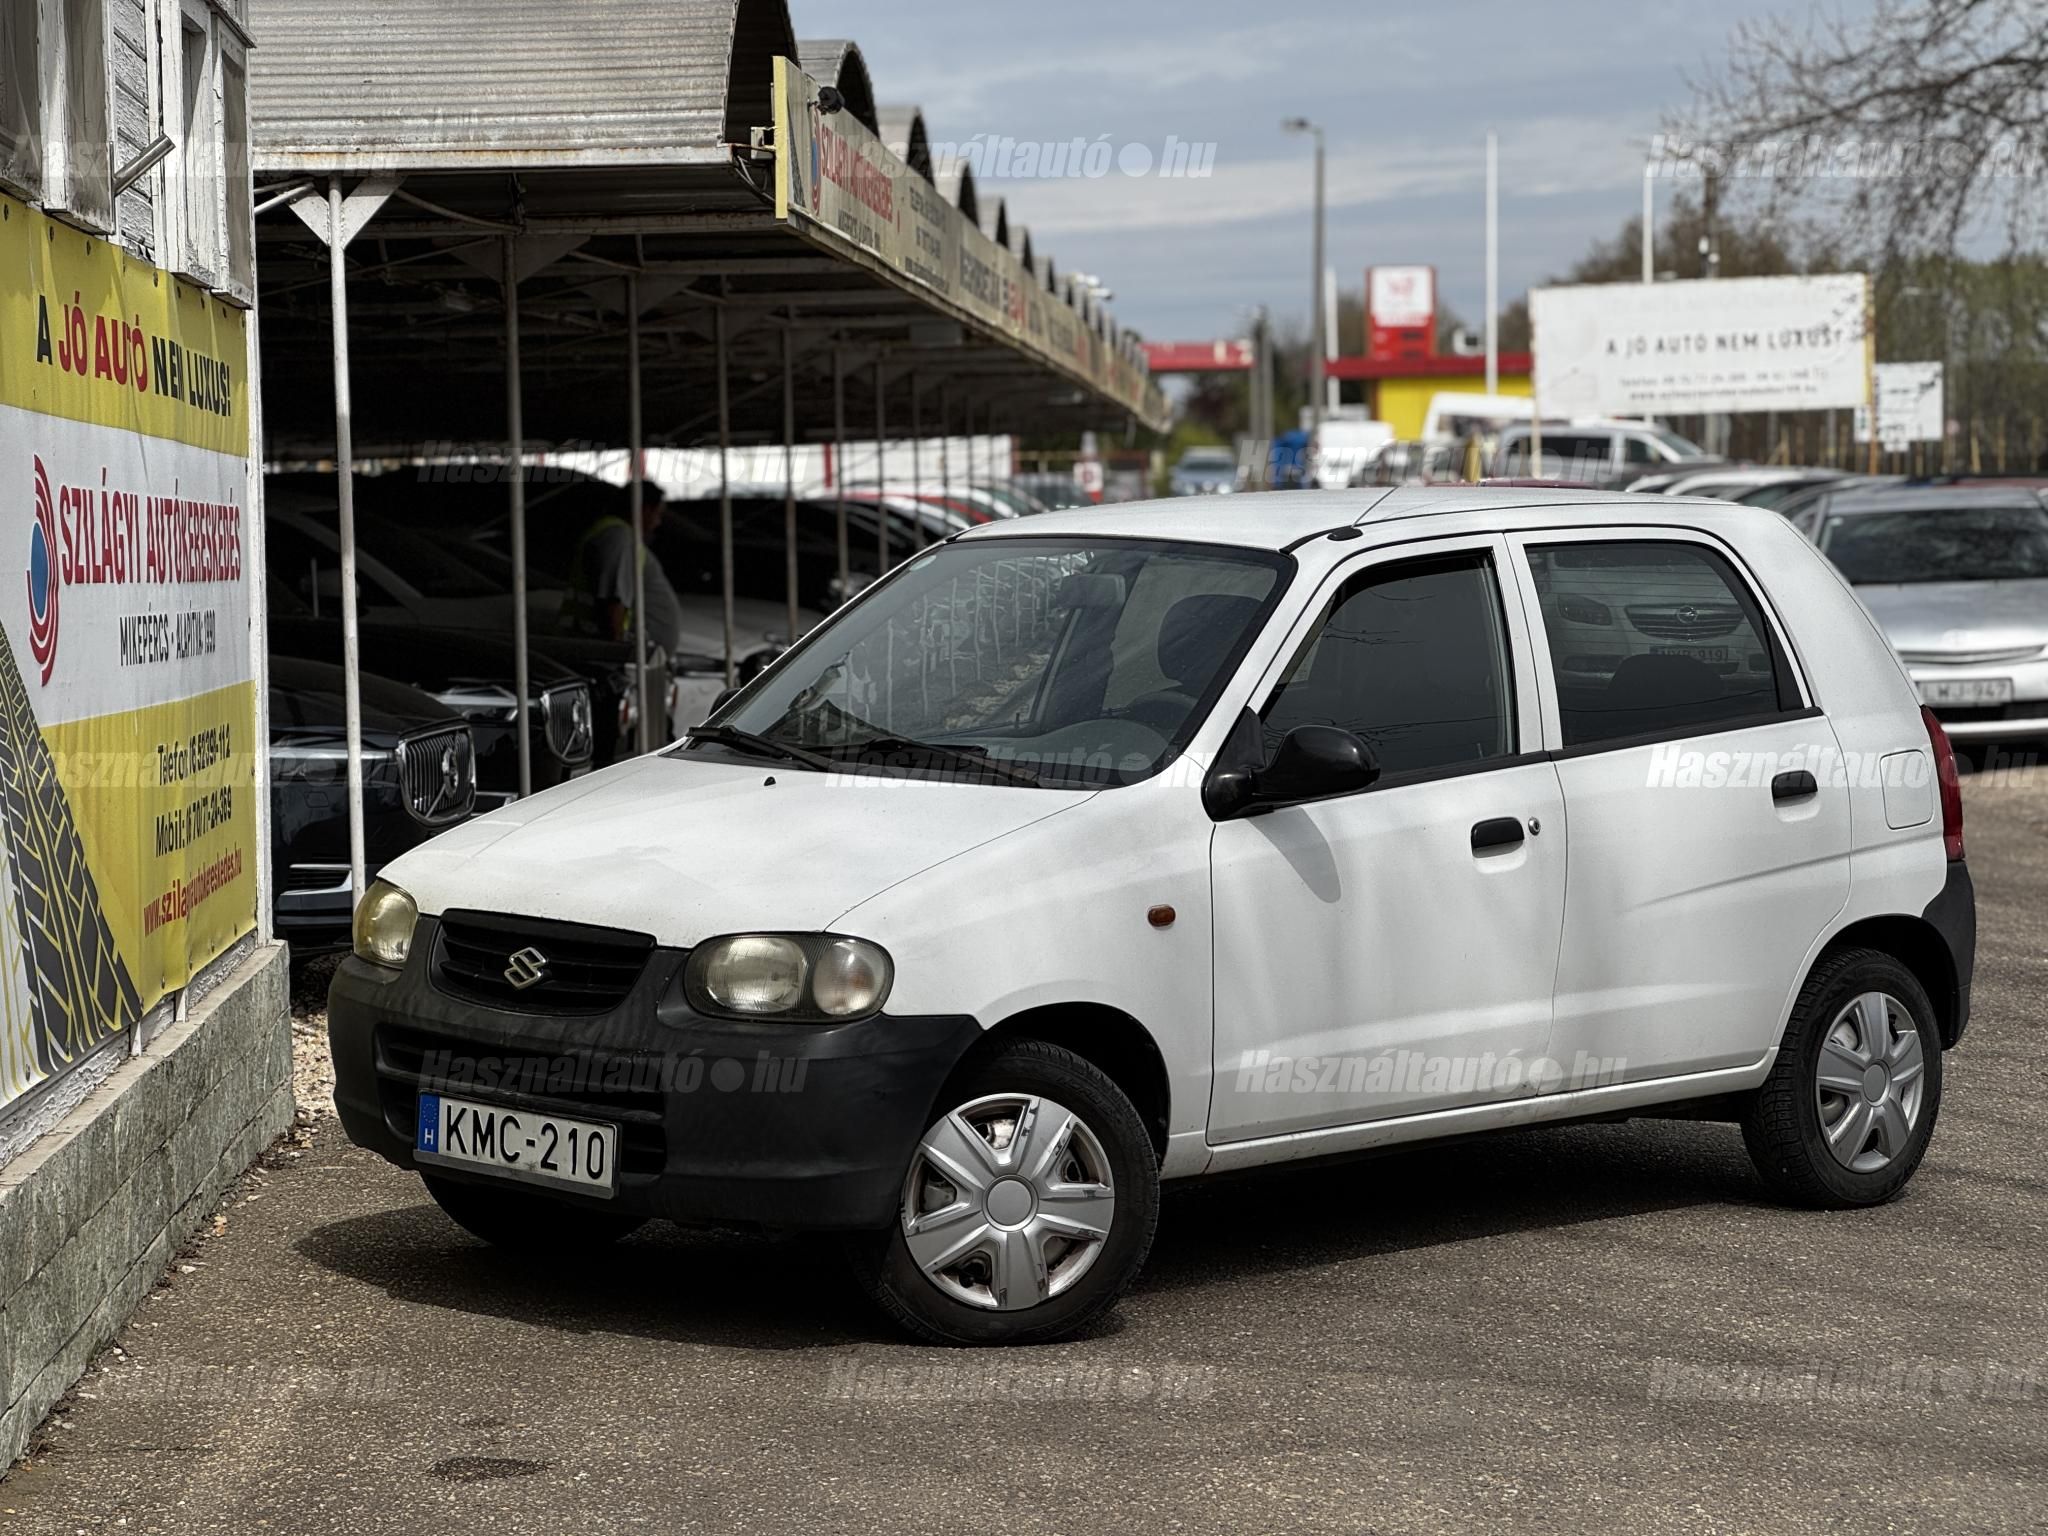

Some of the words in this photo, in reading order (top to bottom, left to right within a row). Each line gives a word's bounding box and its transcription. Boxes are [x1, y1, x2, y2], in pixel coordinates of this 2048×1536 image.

[37, 294, 53, 365] A
[58, 290, 88, 376] JÓ
[186, 350, 231, 417] LUXUS!
[60, 467, 141, 585] SZILÁGYI
[146, 478, 241, 584] AUTÓKERESKEDÉS
[119, 601, 169, 666] MIKEPÉRCS
[425, 1129, 434, 1146] H
[445, 1103, 606, 1180] KMC-210
